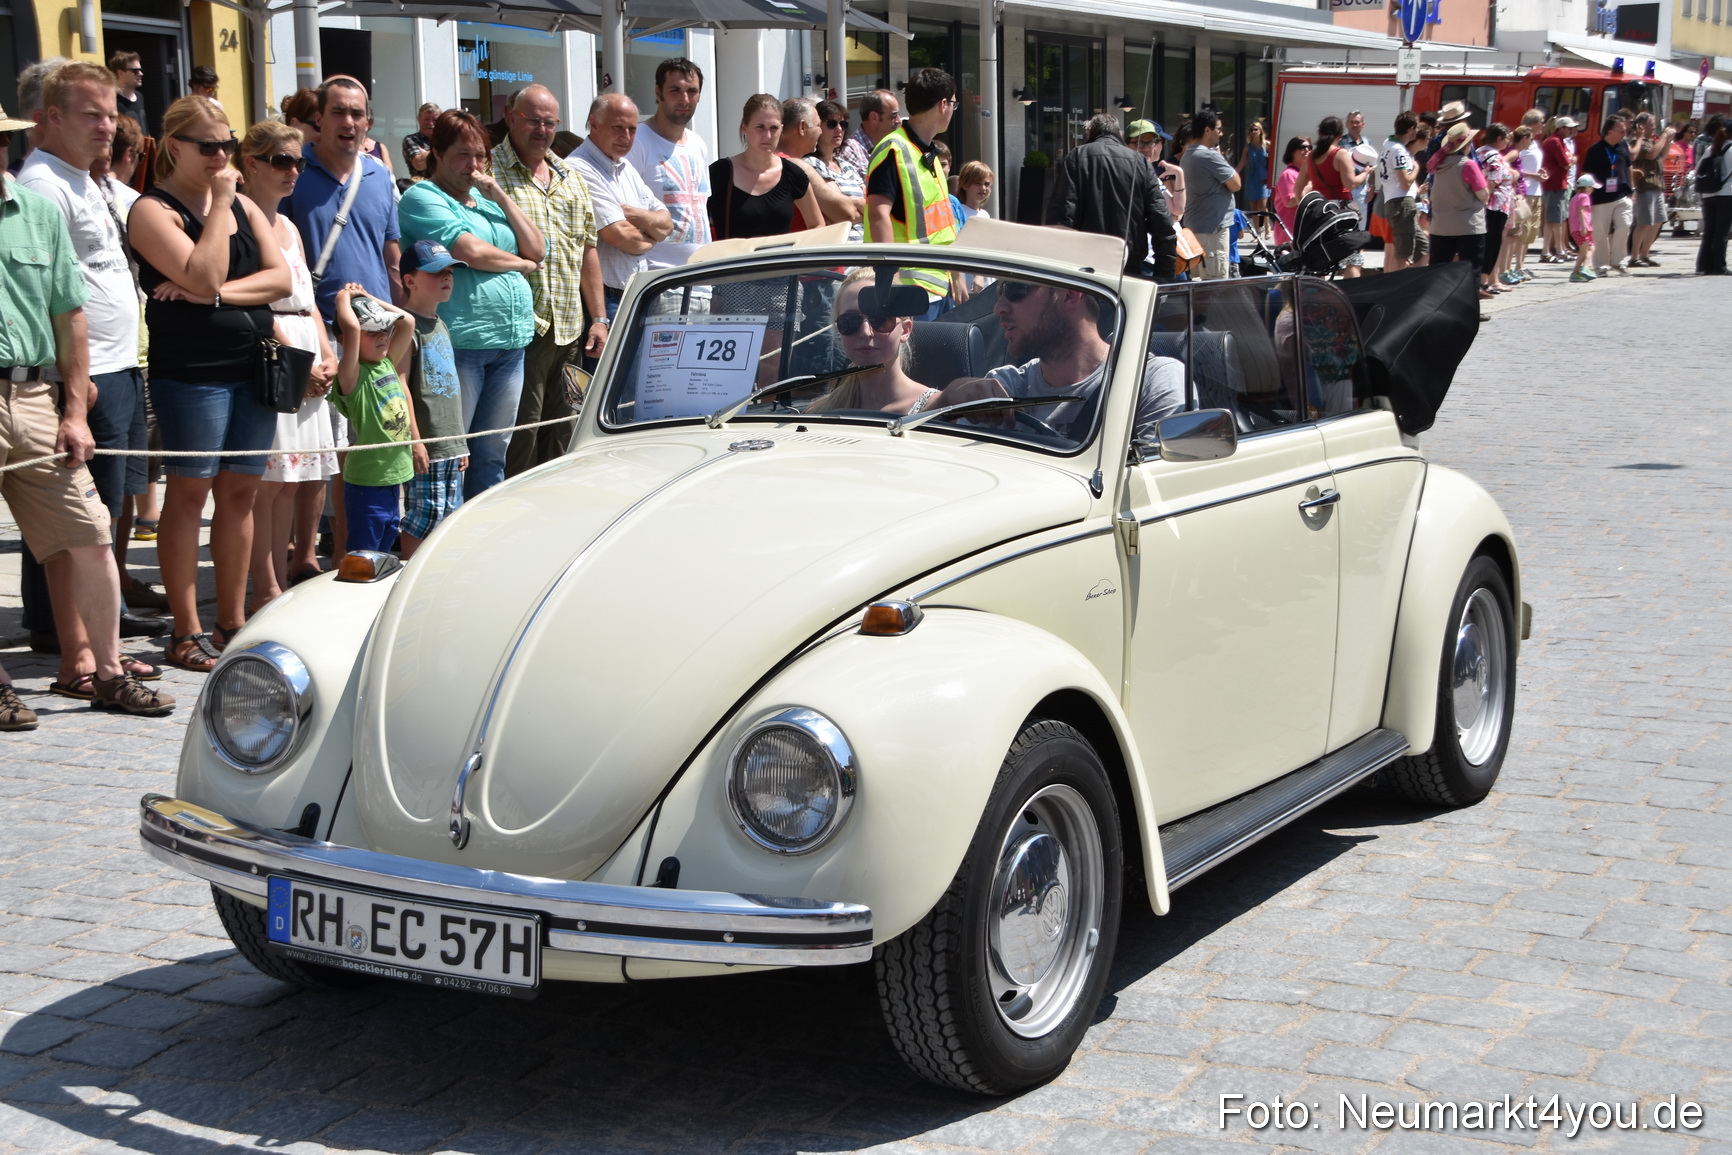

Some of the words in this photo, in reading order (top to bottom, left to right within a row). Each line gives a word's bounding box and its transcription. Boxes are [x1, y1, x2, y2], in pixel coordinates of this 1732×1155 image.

[219, 28, 239, 52] 24
[477, 68, 488, 79] die
[489, 69, 517, 83] günstige
[517, 71, 534, 82] Linie
[695, 339, 737, 362] 128
[275, 916, 285, 931] D
[292, 888, 344, 946] RH
[370, 903, 427, 960] EC
[440, 914, 532, 977] 57H
[285, 948, 423, 982] www.autohausboecklerallee.de
